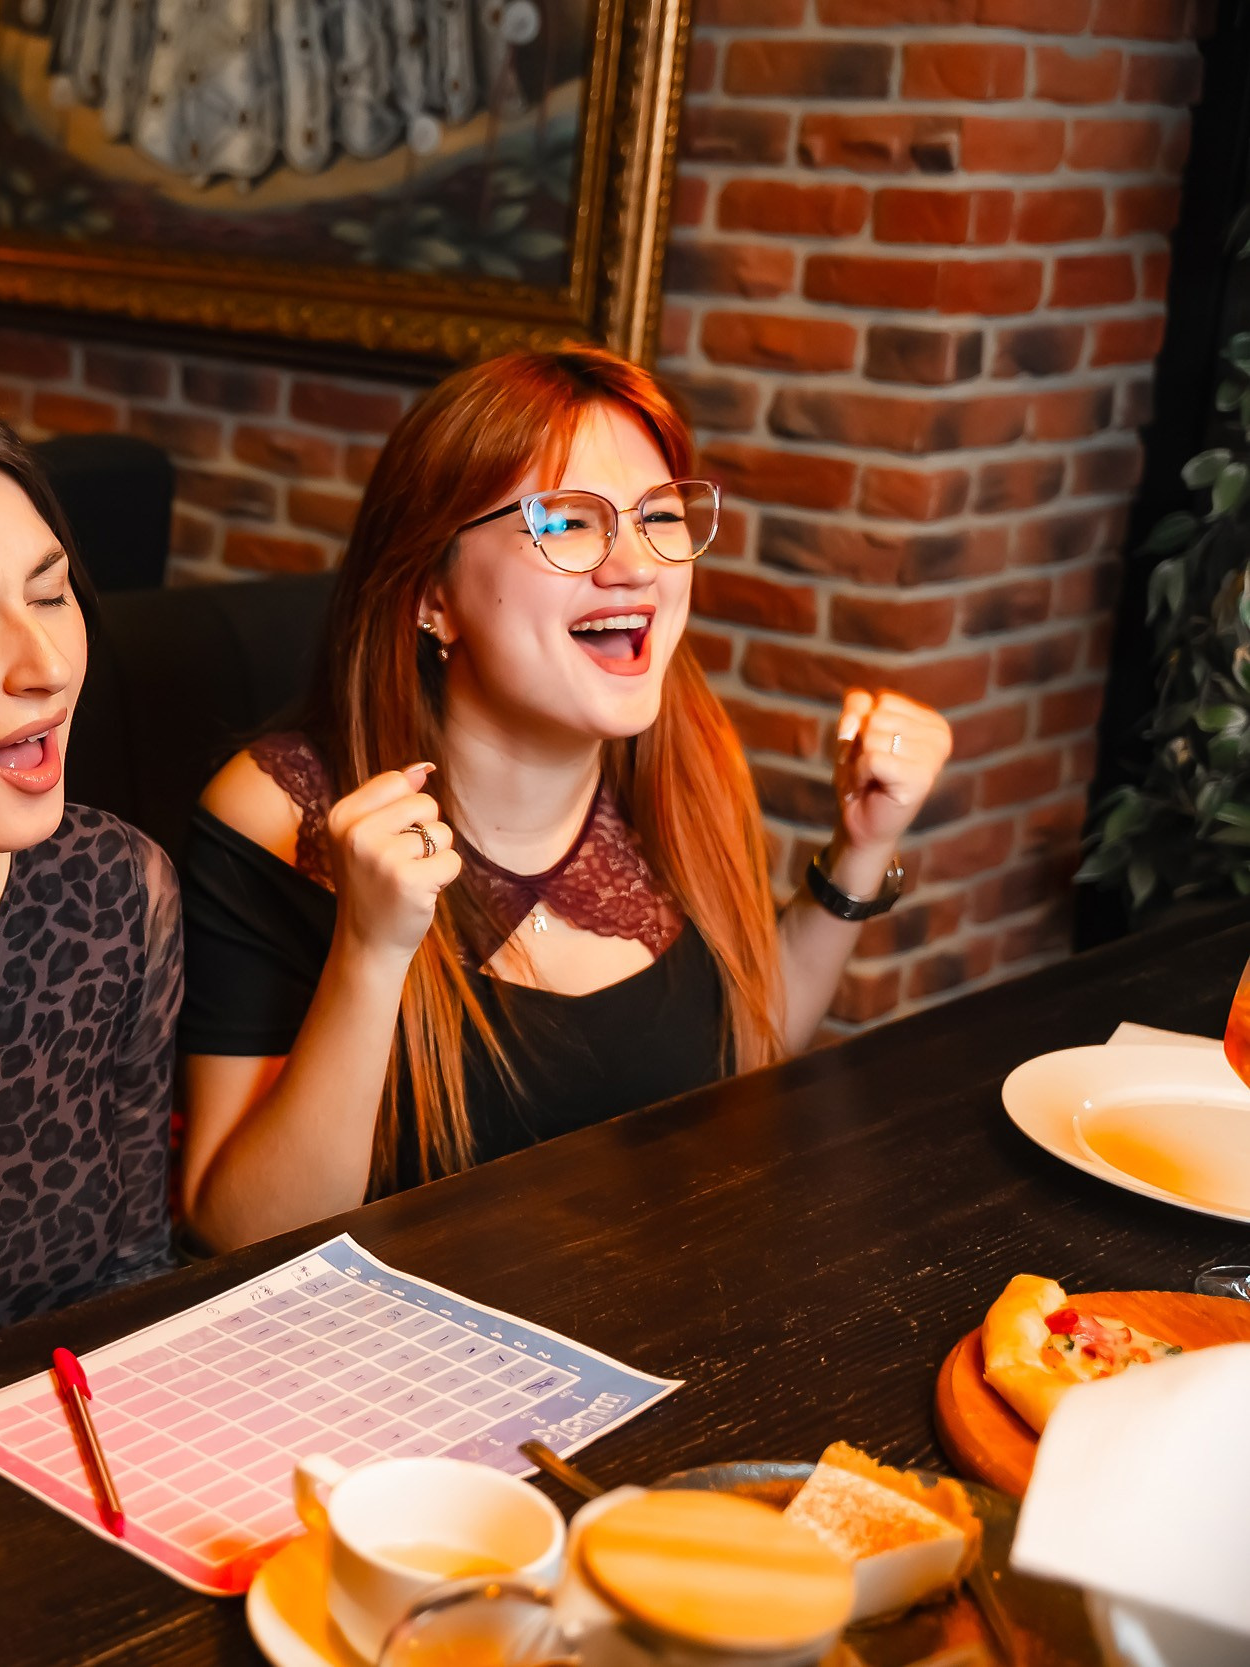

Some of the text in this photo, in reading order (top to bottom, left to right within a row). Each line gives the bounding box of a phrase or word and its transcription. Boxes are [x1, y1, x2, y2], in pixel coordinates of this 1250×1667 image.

[345, 1264, 361, 1277] 10
[368, 1279, 381, 1287] 9
[392, 1289, 405, 1297] 8
[416, 1298, 429, 1306] 7
[464, 1320, 479, 1328] 5
[490, 1331, 503, 1339] 4
[513, 1340, 528, 1349] 3
[537, 1350, 551, 1359] 2
[567, 1364, 581, 1372] 1
[531, 1416, 547, 1424] 2
[488, 1438, 504, 1447] 3
